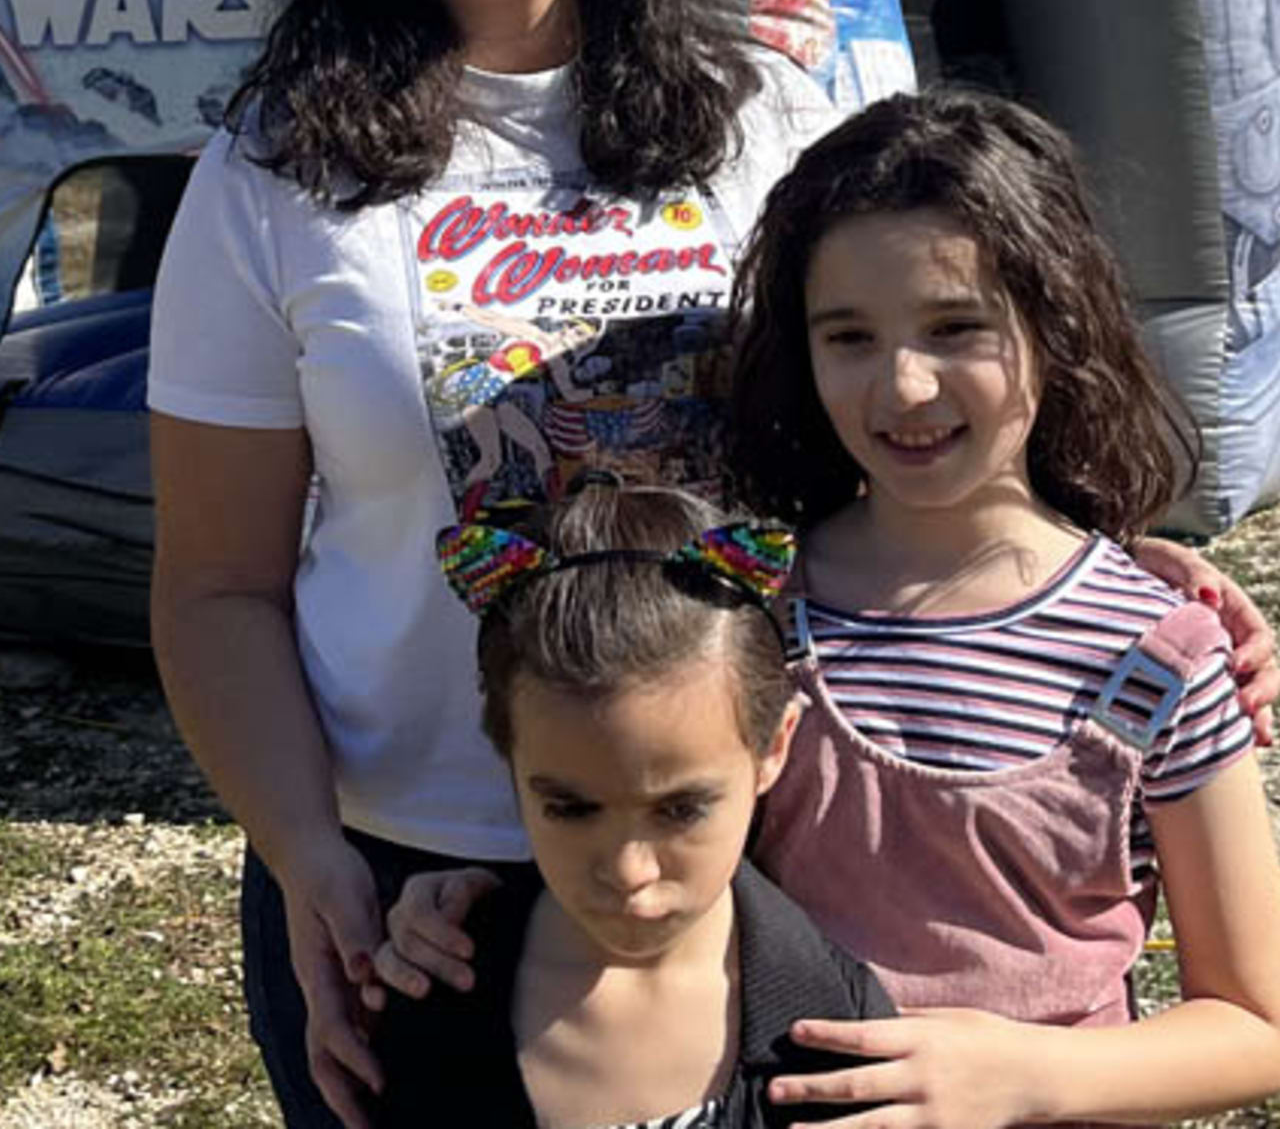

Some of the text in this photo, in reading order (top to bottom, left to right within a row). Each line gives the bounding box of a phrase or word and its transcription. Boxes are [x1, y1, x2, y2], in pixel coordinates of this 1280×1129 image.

[417, 195, 633, 263] Wonder
[471, 240, 727, 307] Woman
[586, 280, 630, 292] FOR
[537, 291, 725, 315] PRESIDENT
